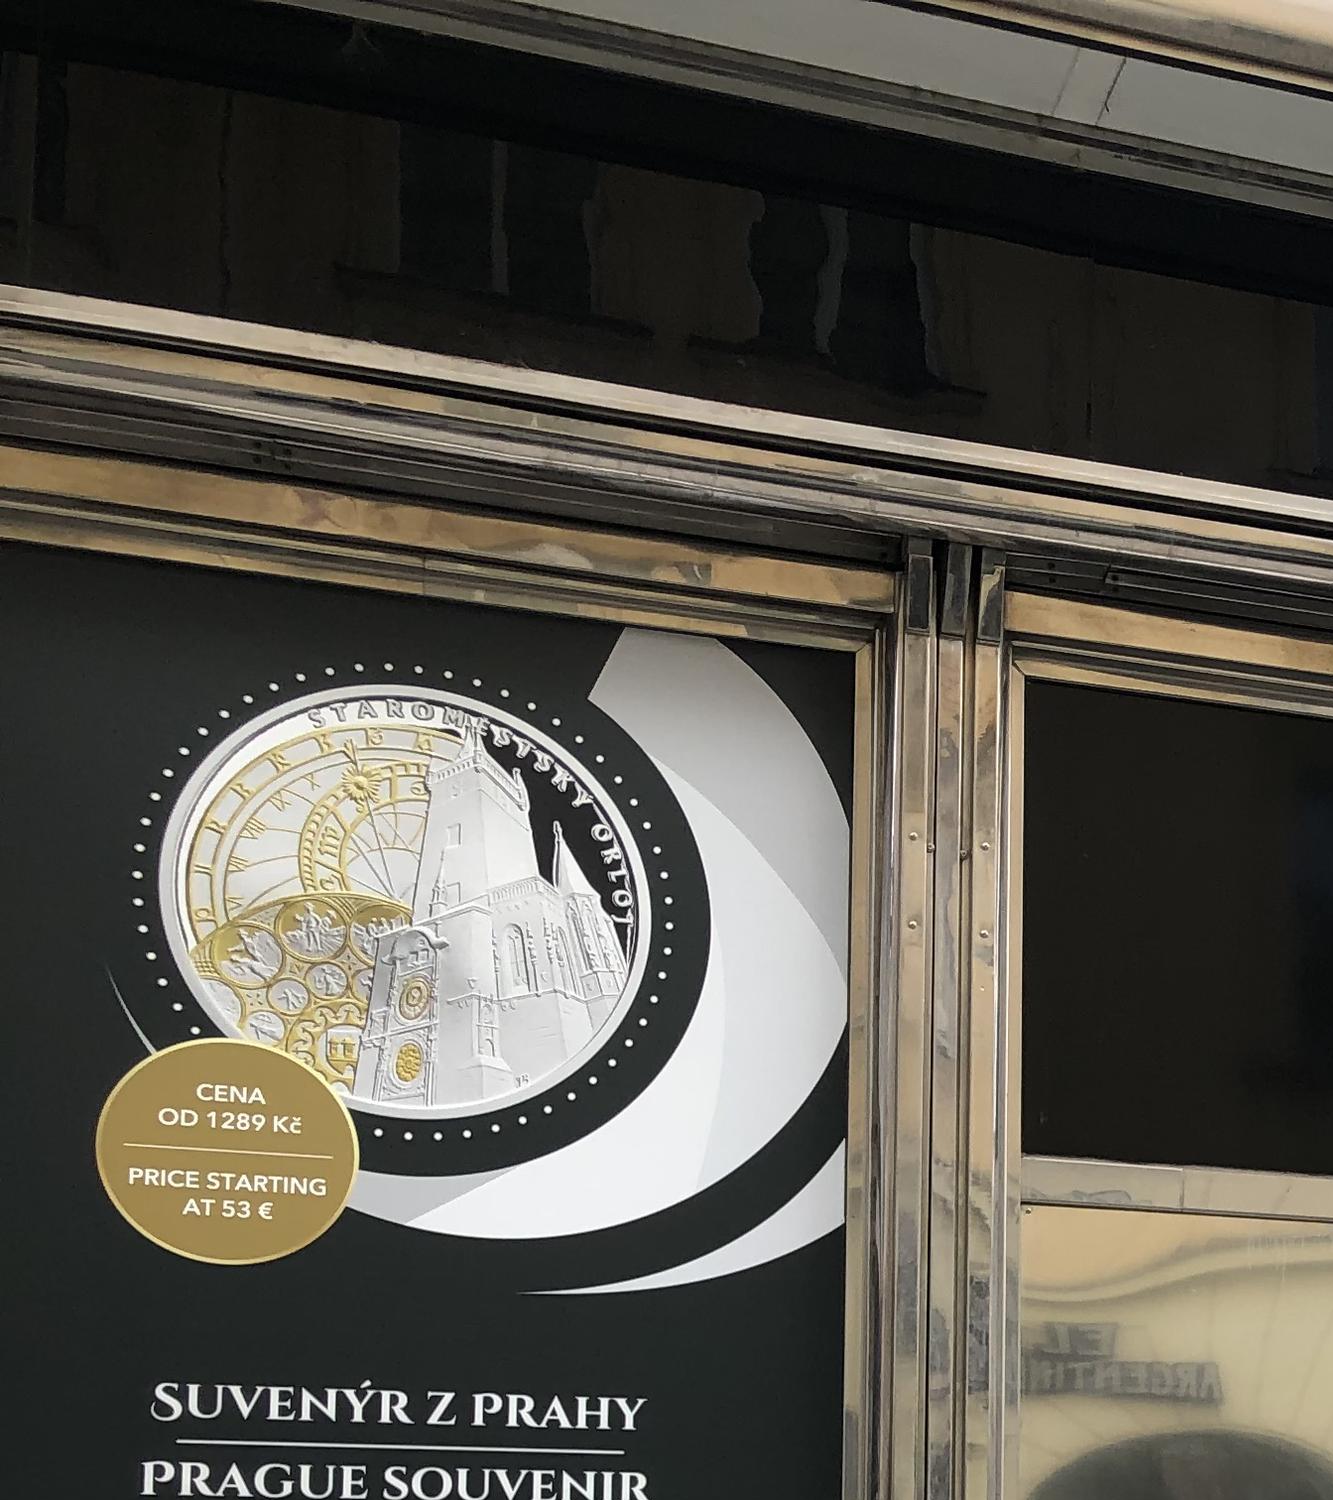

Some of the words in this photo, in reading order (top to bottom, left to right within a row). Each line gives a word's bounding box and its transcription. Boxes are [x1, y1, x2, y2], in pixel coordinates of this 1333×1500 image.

[196, 1083, 266, 1105] CENA
[158, 1108, 198, 1127] OD
[206, 1111, 266, 1132] 1289
[273, 1116, 302, 1134] Kč
[128, 1168, 199, 1188] PRICE
[206, 1172, 326, 1196] STARTING
[182, 1199, 216, 1216] AT
[222, 1201, 251, 1219] 53
[258, 1202, 273, 1220] €
[151, 1379, 414, 1425] SUVENÝR
[426, 1391, 457, 1426] Z
[471, 1393, 648, 1431] PRAHY
[140, 1461, 369, 1499] PRAGUE
